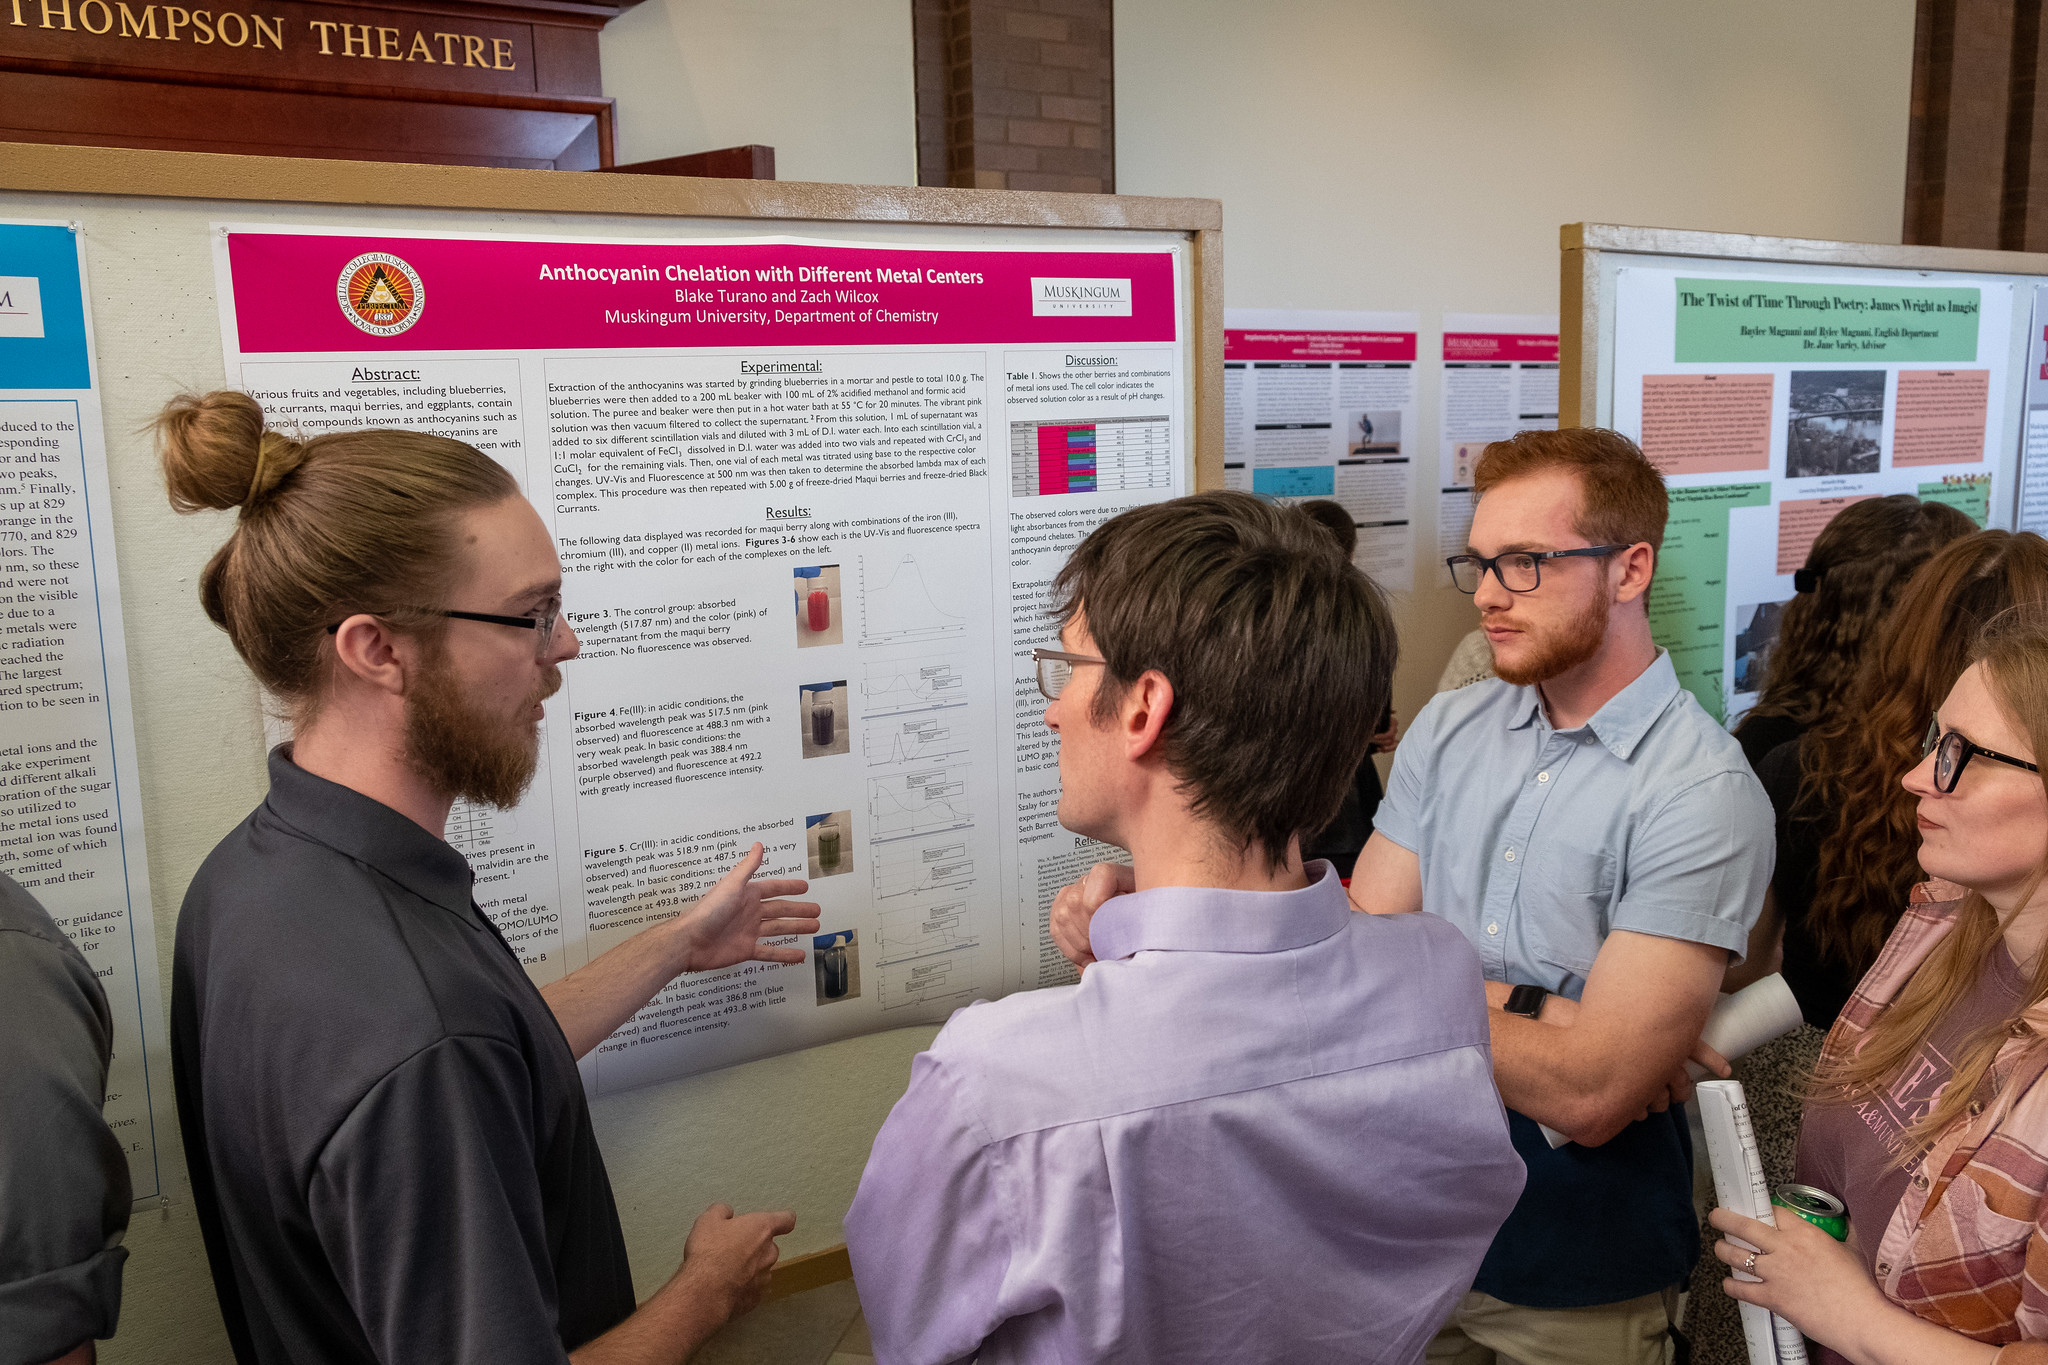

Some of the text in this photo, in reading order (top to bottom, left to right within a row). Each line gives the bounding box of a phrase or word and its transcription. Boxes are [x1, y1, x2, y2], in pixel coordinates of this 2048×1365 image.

[310, 20, 517, 71] THEATRE
[539, 264, 983, 284] Anthocyanin Chelation with Different Metal Centers
[675, 288, 878, 302] Blake Turano and Zach Wilcox
[1044, 285, 1120, 299] MUSKINGUM
[1681, 293, 1978, 314] The Twist of Time Through Poetry: James Wright as Imagist
[605, 308, 938, 326] Muskingum University, Department of Chemistry
[1066, 355, 1118, 366] Discussion:
[352, 368, 420, 380] Abstract:
[741, 360, 822, 376] Experimental:
[548, 382, 595, 392] Extraction
[598, 382, 608, 390] of
[610, 382, 625, 390] the
[628, 381, 684, 391] anthocyanins
[705, 379, 734, 388] started
[737, 379, 747, 389] by
[749, 378, 782, 389] grinding
[784, 377, 828, 386] blueberries
[892, 375, 913, 385] pestle
[926, 374, 943, 382] total
[946, 374, 960, 382] 10.0
[962, 376, 968, 384] g.
[1006, 372, 1028, 380] Table
[247, 385, 506, 400] Various fruits and vegetables, including blueberries,
[1007, 395, 1038, 404] observed
[1128, 392, 1138, 402] pH
[1139, 392, 1164, 401] changes.
[330, 402, 360, 414] maqui
[364, 402, 402, 411] berries,
[406, 400, 423, 409] and
[427, 400, 474, 411] eggplants,
[477, 398, 512, 407] contain
[19, 468, 58, 481] peaks,
[30, 483, 76, 495] Finally,
[766, 506, 812, 519] Results:
[0, 528, 78, 542] 770, and 829
[559, 538, 577, 547] The
[580, 536, 620, 545] following
[622, 534, 641, 542] data
[644, 530, 683, 542] displayed
[704, 526, 742, 536] recorded
[744, 526, 757, 534] for
[759, 524, 783, 534] maqui
[786, 523, 807, 532] berry
[810, 521, 830, 530] along
[851, 517, 900, 526] combinations
[902, 514, 910, 522] of
[943, 512, 957, 521] (III),
[567, 598, 735, 622] Figure 3. The control group: absorbed
[574, 711, 606, 722] Figure
[609, 708, 617, 716] 4.
[619, 705, 646, 716] Fe(III):
[658, 701, 681, 710] acidic
[684, 697, 729, 707] conditions,
[730, 694, 743, 702] the
[12, 766, 96, 785] different alkali
[1032, 788, 1057, 797] authors
[1018, 824, 1033, 833] Seth
[479, 894, 527, 908] with metal
[72, 912, 123, 926] guidance
[598, 1042, 627, 1053] change
[640, 1030, 692, 1044] fluorescence
[694, 1021, 729, 1032] intensity.
